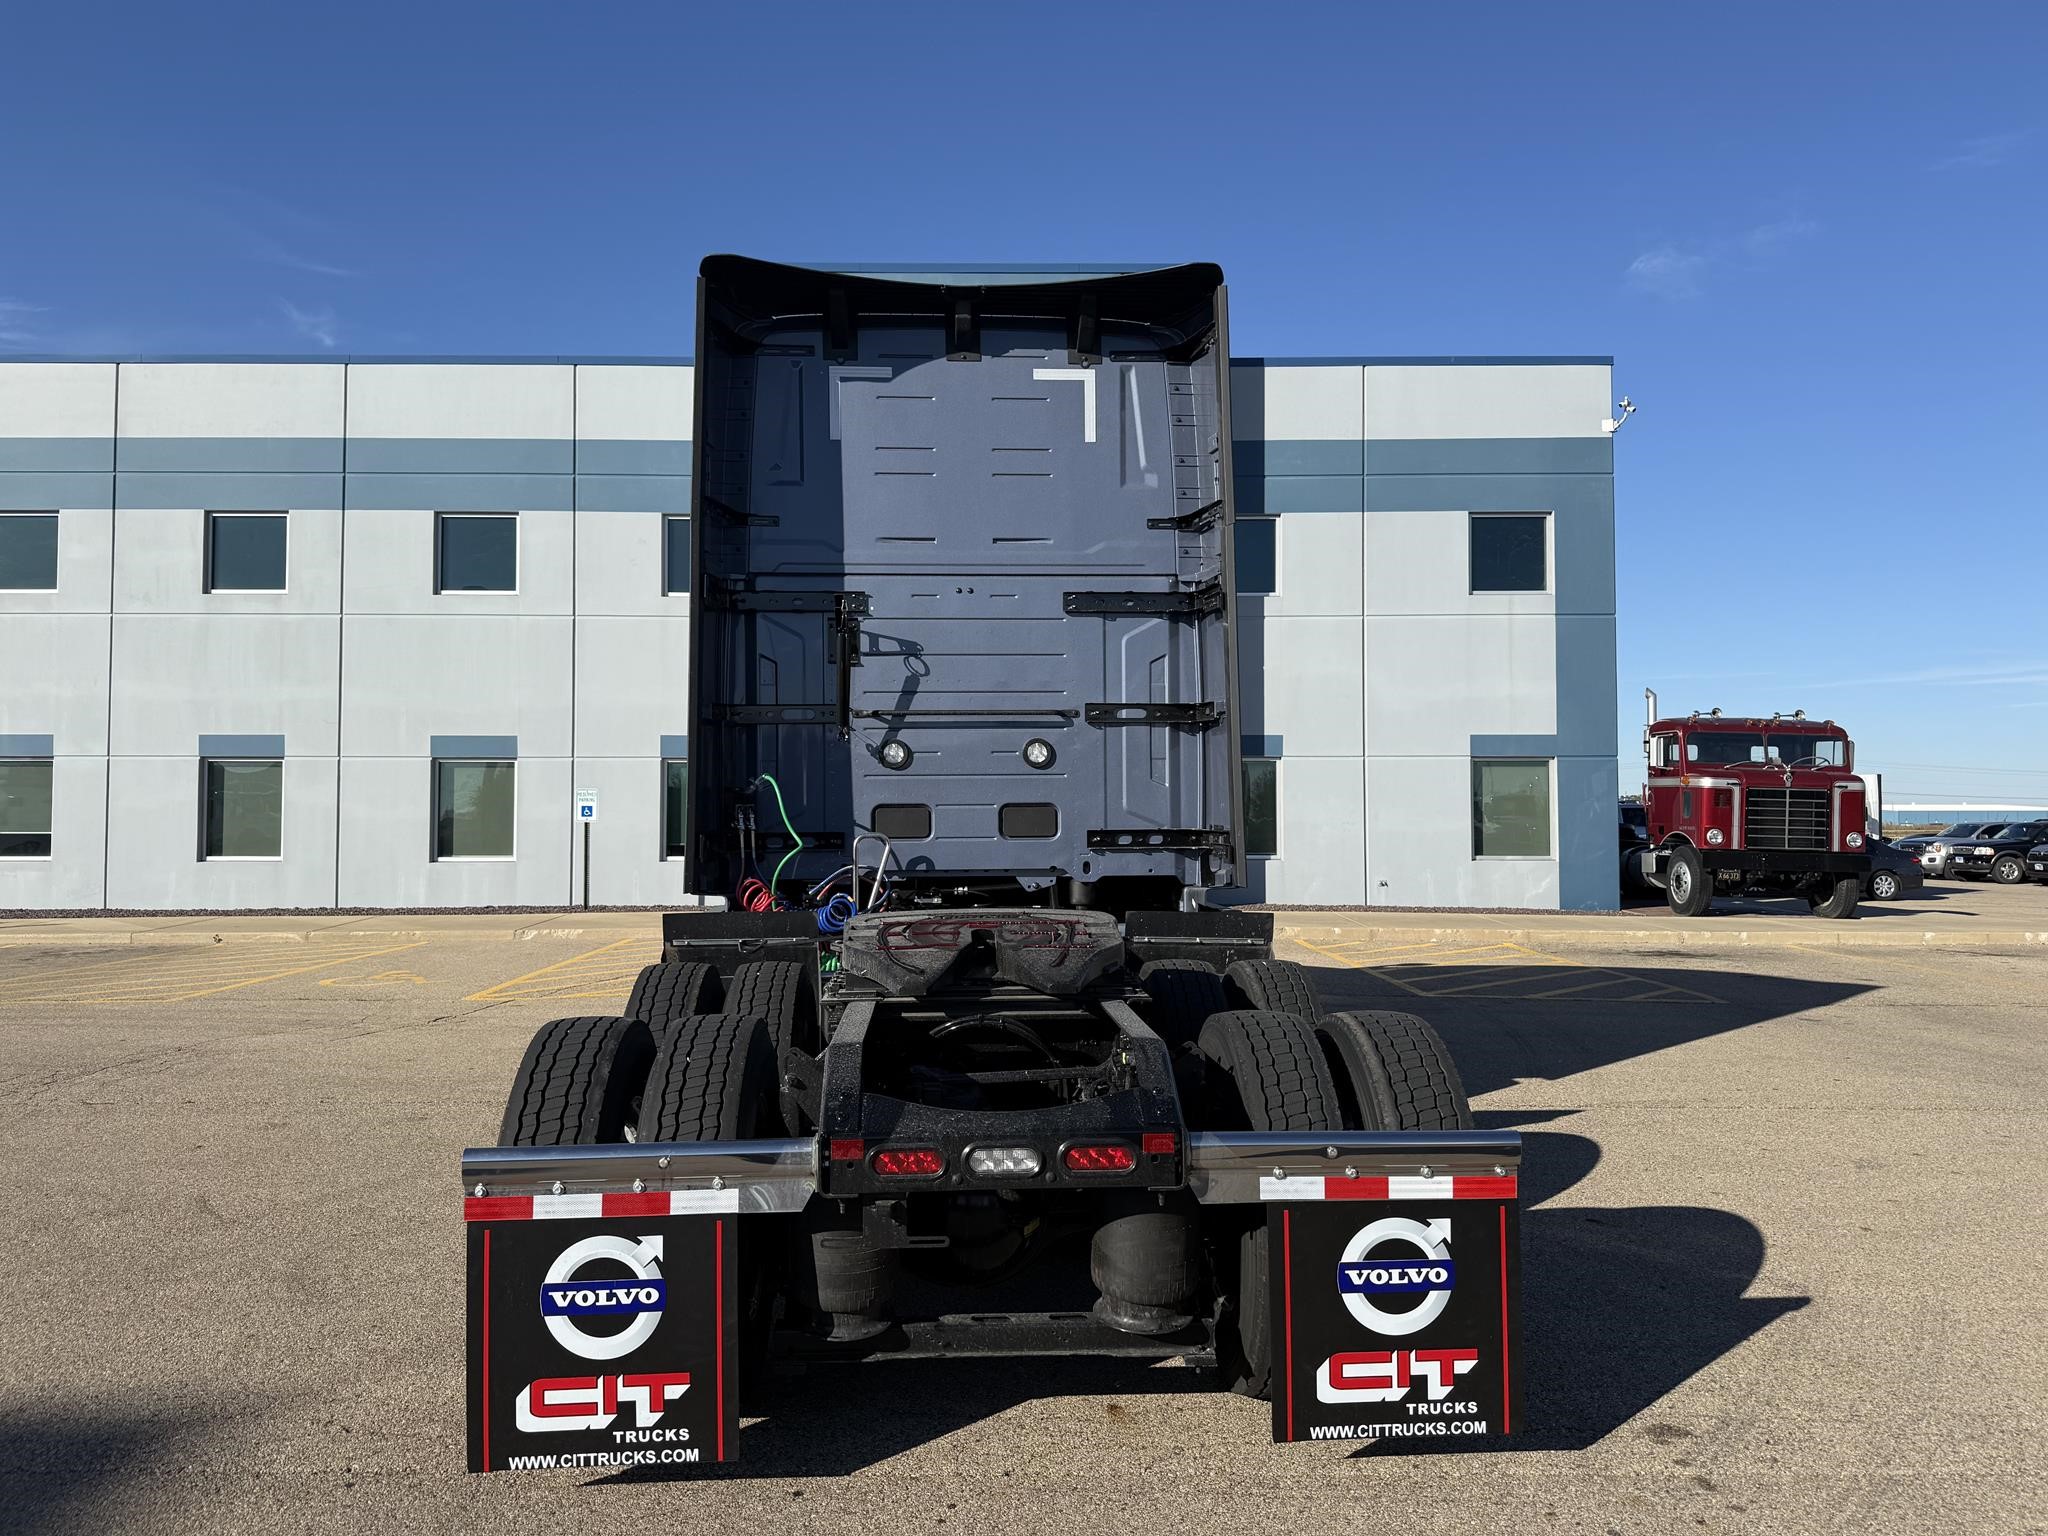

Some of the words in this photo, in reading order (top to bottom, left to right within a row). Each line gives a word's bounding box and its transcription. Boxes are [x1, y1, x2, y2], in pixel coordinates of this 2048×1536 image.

[1344, 1267, 1448, 1285] VOLVO
[547, 1287, 660, 1308] VOLVO
[1316, 1348, 1479, 1404] CIT
[515, 1371, 691, 1432] CIT
[1406, 1401, 1478, 1416] TRUCKS
[612, 1428, 690, 1444] TRUCKS
[1309, 1420, 1487, 1440] WWW.CITTRUCKS.COM
[508, 1447, 699, 1471] WWW.CITTRUCKS.COM
